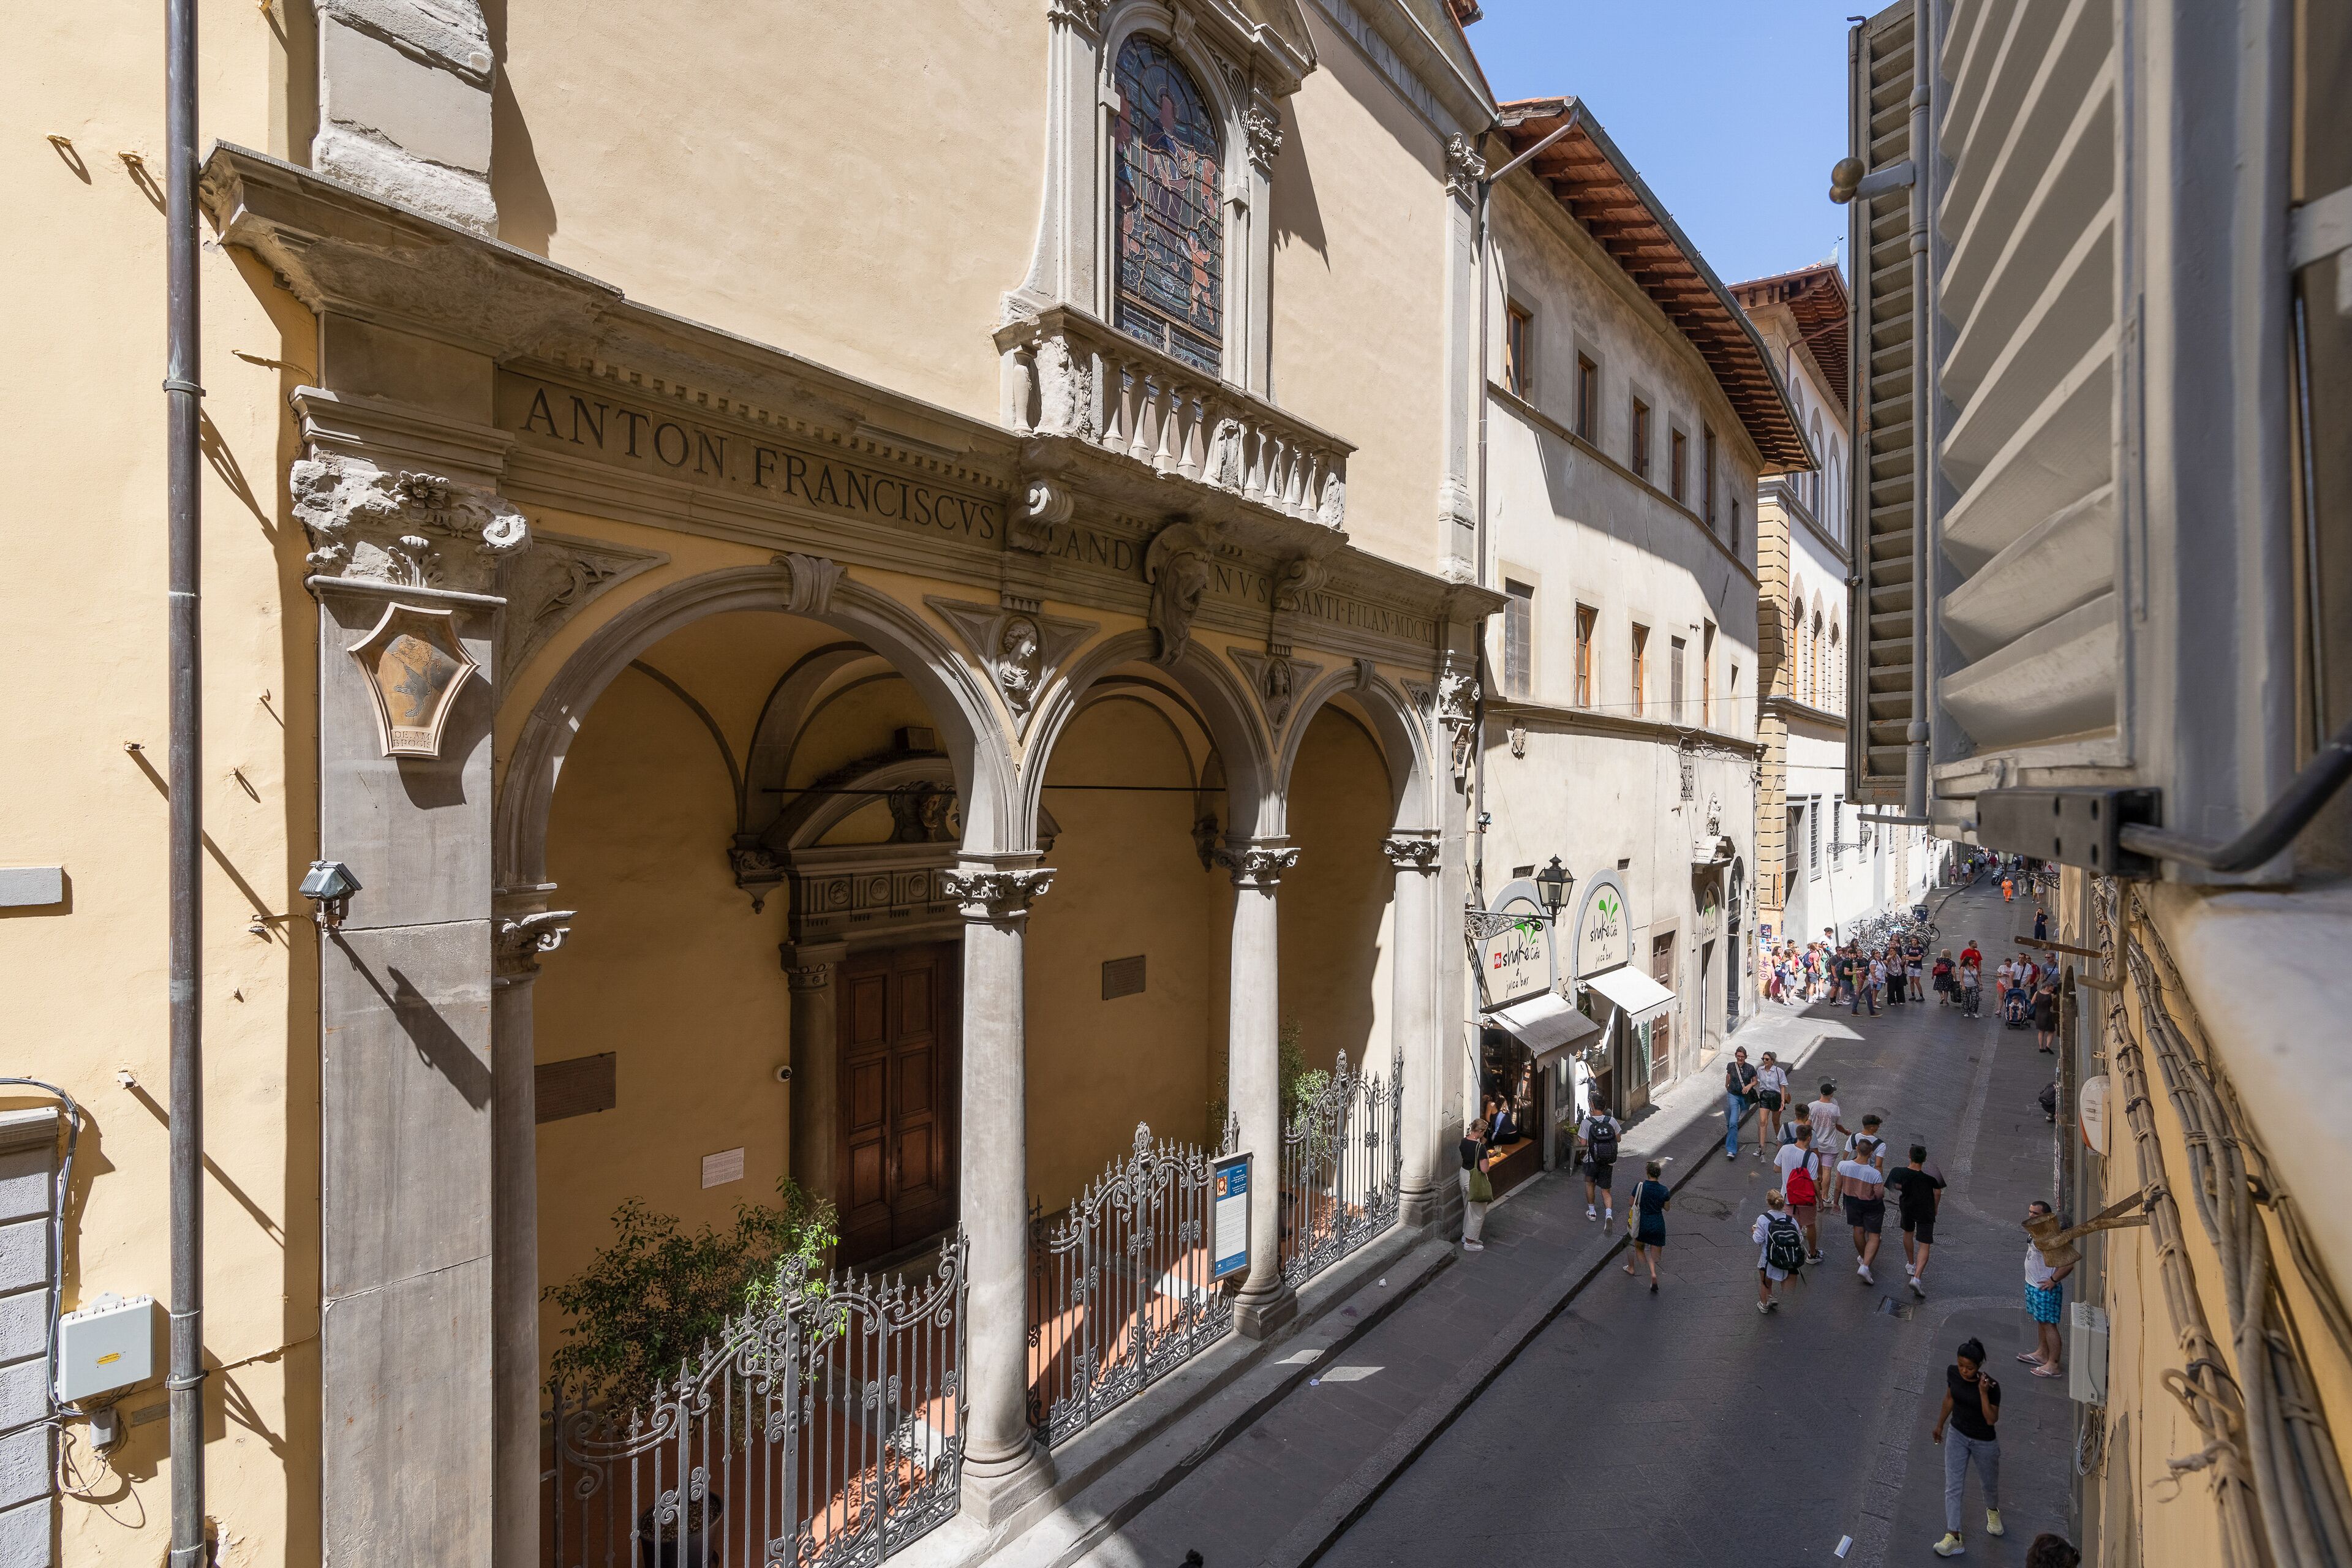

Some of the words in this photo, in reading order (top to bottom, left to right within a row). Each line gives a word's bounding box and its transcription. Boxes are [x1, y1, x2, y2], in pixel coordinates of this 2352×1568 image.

[753, 447, 995, 540] FRANCISCVS
[1589, 913, 1610, 942] shake
[1502, 933, 1529, 967] shake
[1595, 954, 1605, 969] juice
[1506, 981, 1519, 998] juice
[1520, 973, 1529, 987] bar
